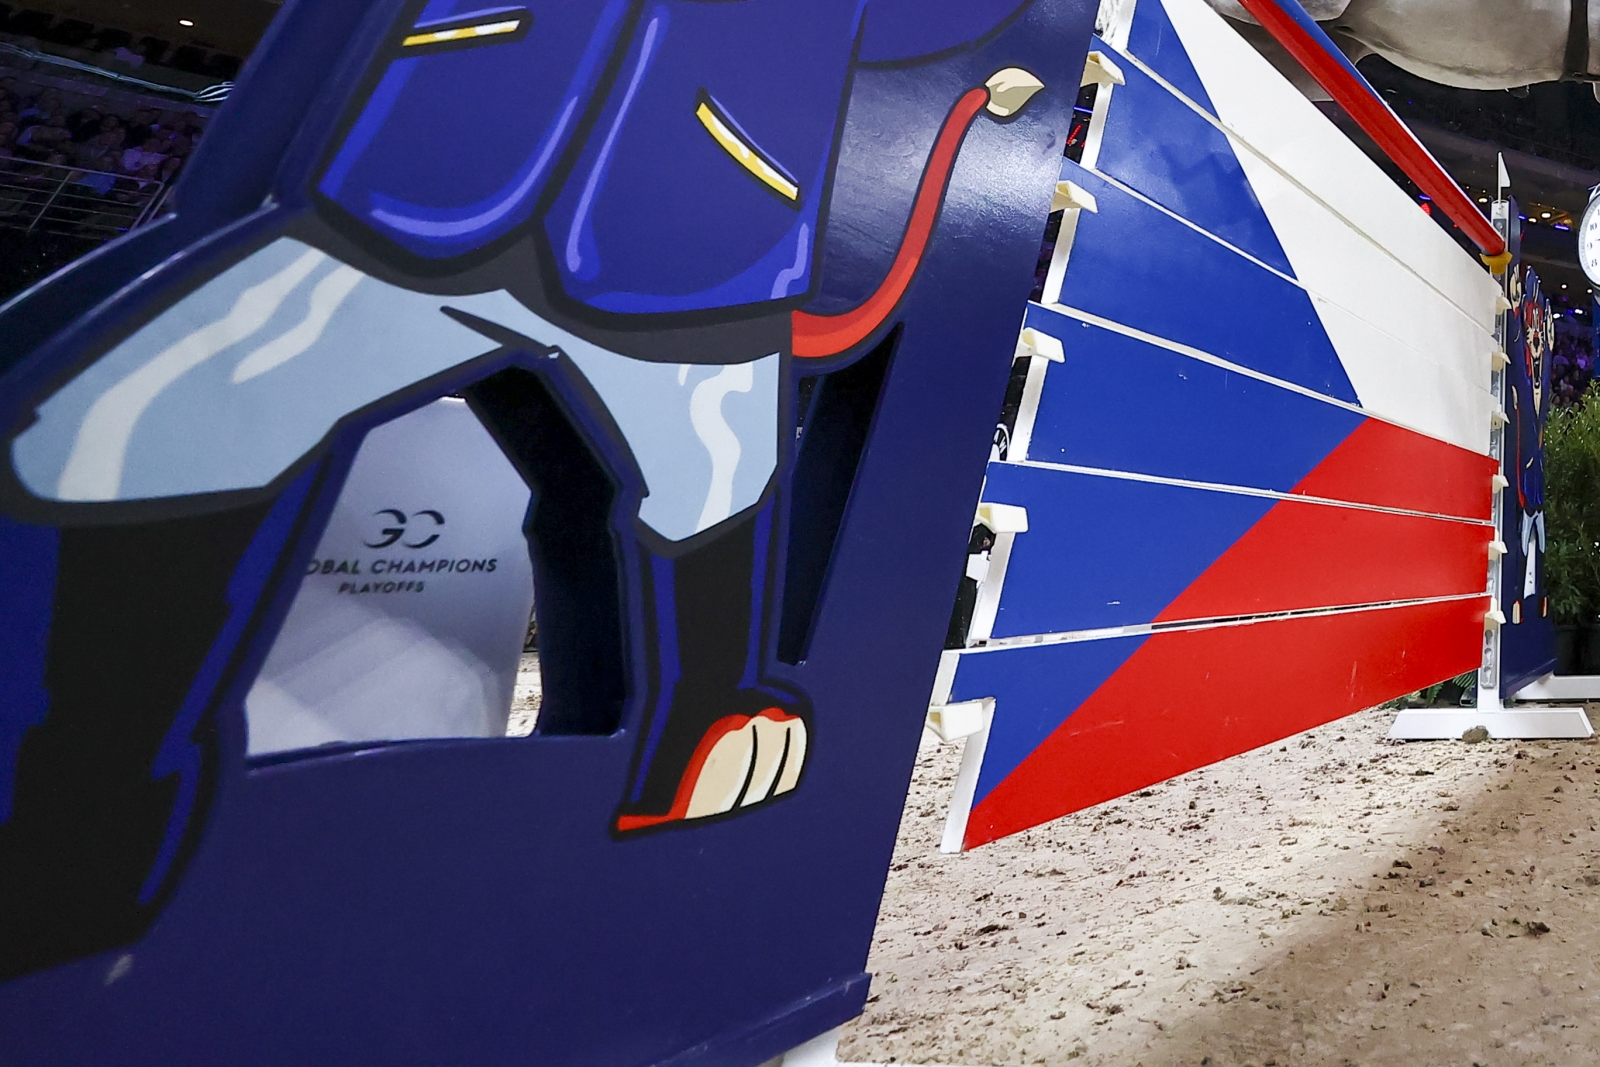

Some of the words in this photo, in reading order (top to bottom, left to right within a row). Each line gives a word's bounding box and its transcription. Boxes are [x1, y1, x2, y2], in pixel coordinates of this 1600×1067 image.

[305, 559, 361, 575] OBAL
[371, 558, 498, 575] CHAMPIONS
[338, 580, 425, 594] PLAYOFFS
